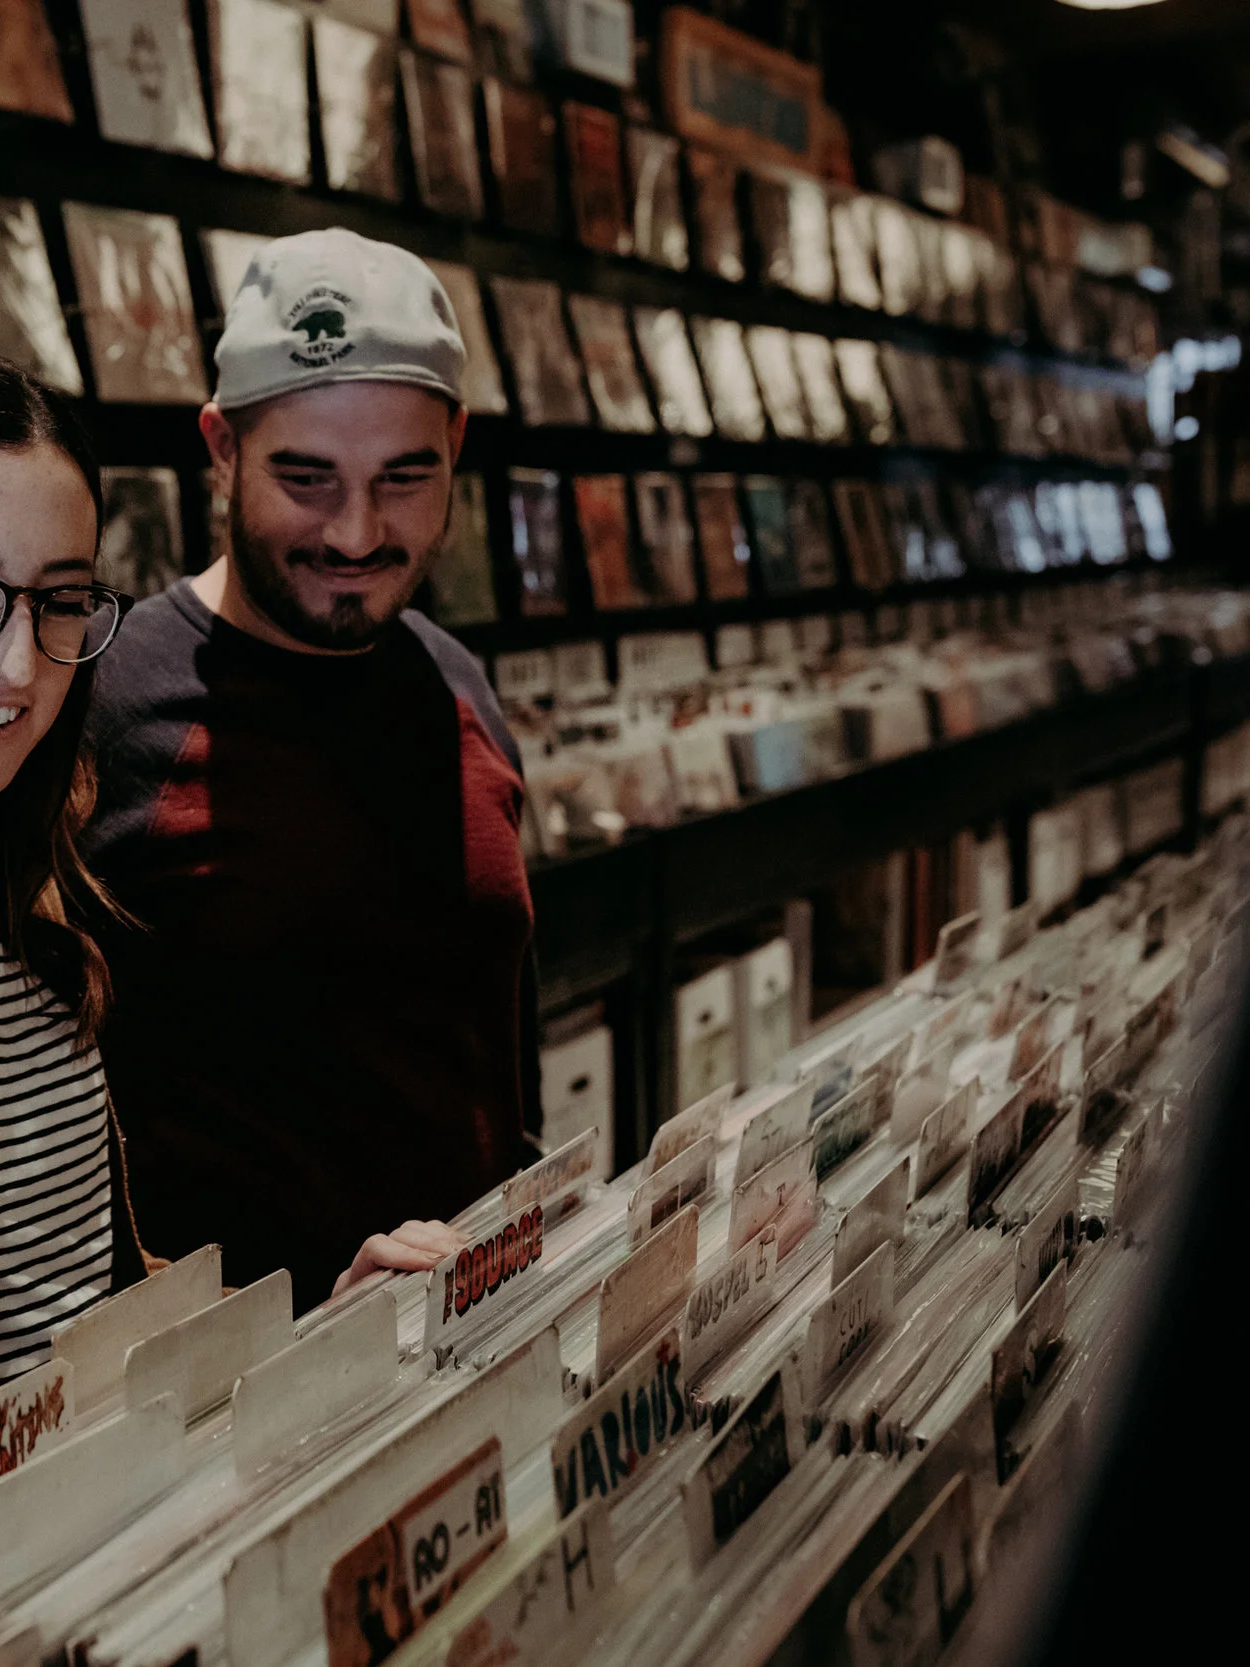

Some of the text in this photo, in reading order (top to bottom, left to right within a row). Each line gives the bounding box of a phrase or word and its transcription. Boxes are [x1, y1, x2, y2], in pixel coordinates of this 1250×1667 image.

[307, 342, 334, 354] 1872
[454, 1204, 543, 1318] SOURCE
[554, 1344, 684, 1520] VARIOUS
